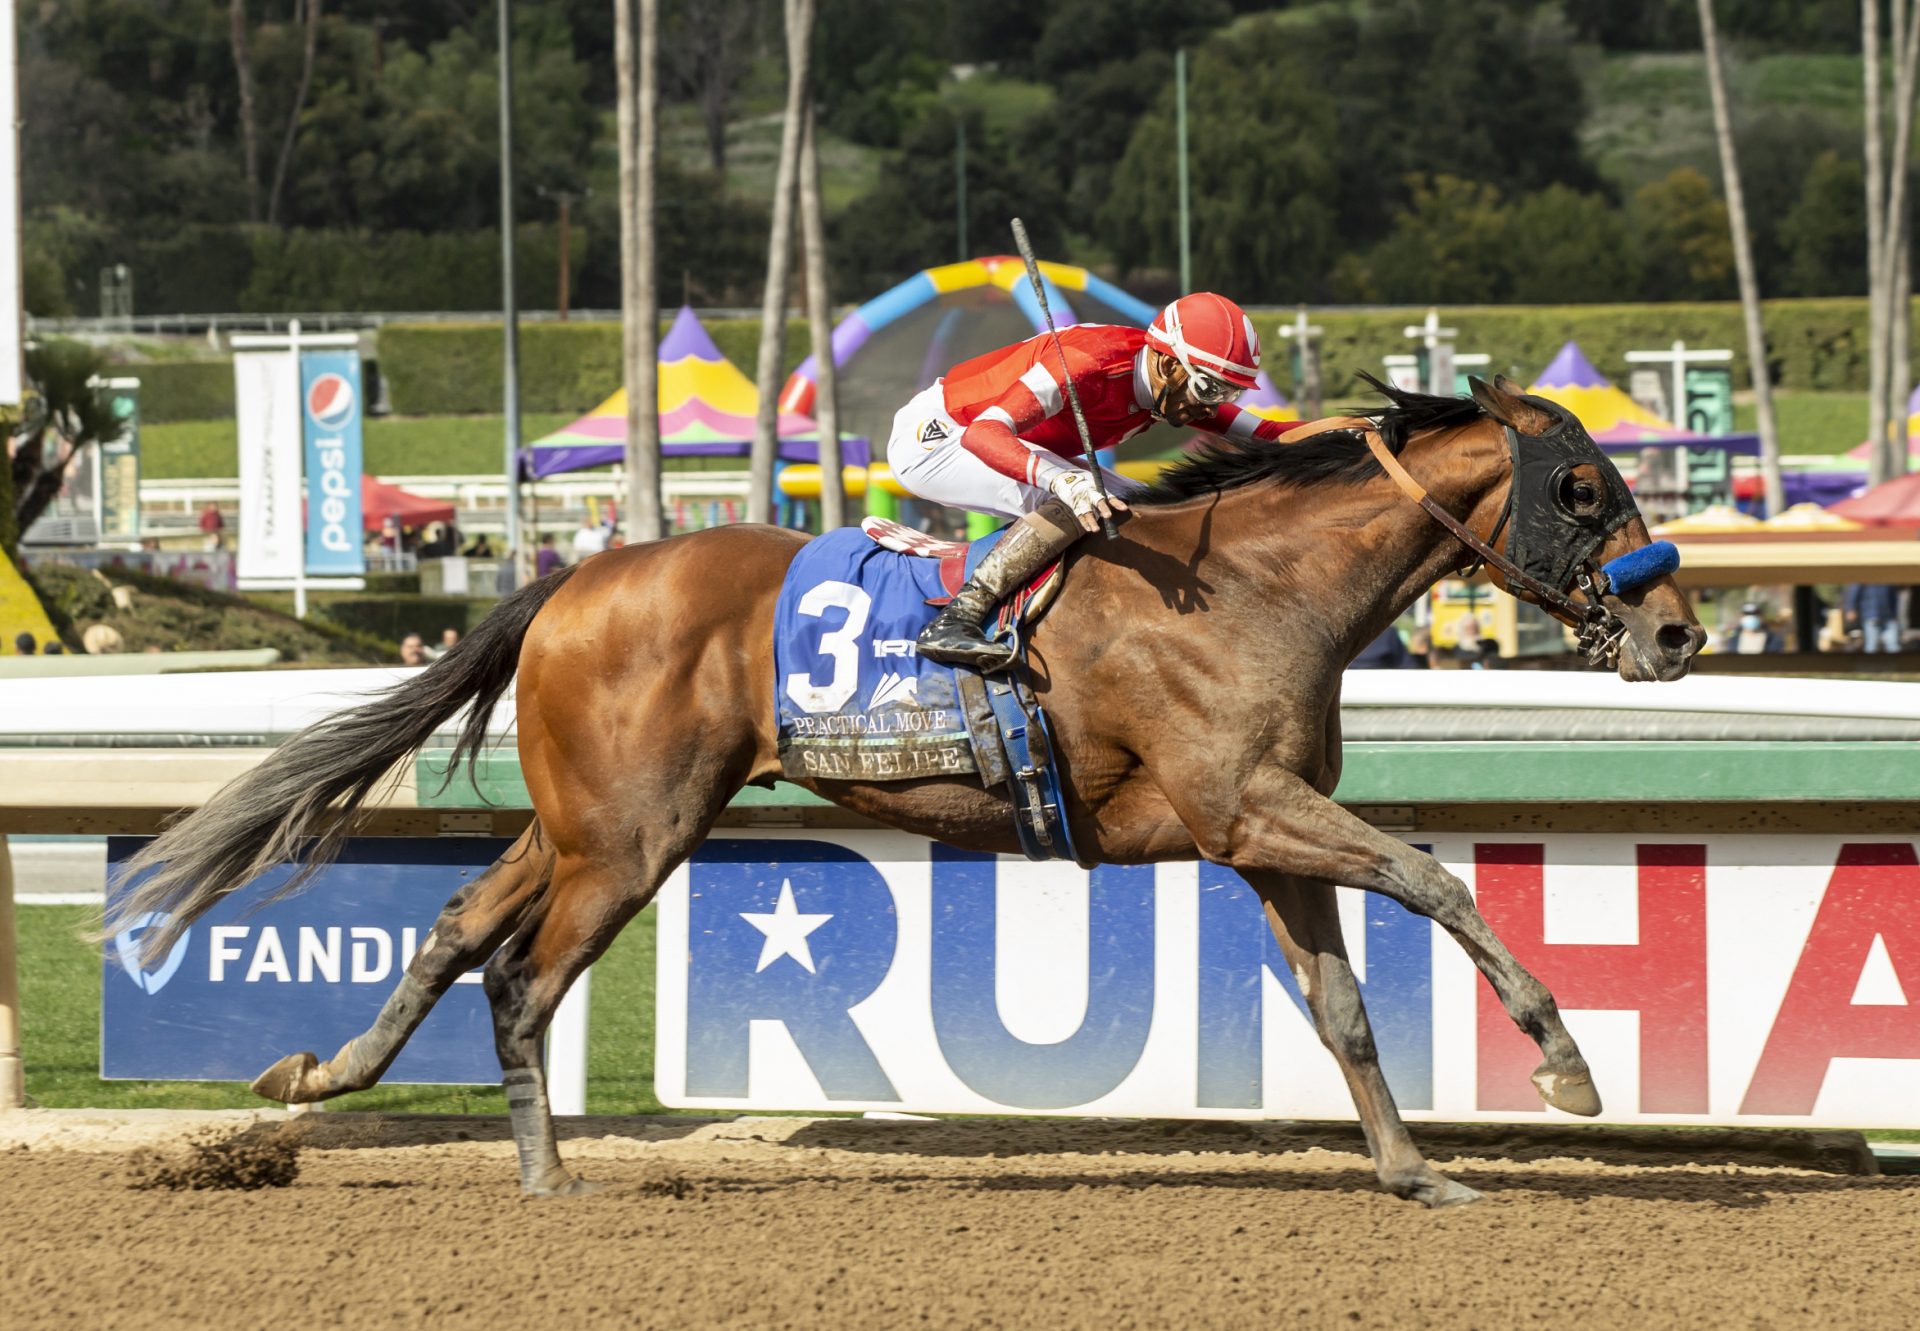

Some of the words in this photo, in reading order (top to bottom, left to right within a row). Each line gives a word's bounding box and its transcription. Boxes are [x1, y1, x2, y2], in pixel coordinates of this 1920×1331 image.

[315, 436, 353, 552] pepsi
[786, 580, 871, 713] 3
[792, 713, 890, 735] PRACTICAL
[895, 710, 946, 732] MOVE
[803, 750, 849, 774] SAN
[858, 747, 960, 774] FELIPE
